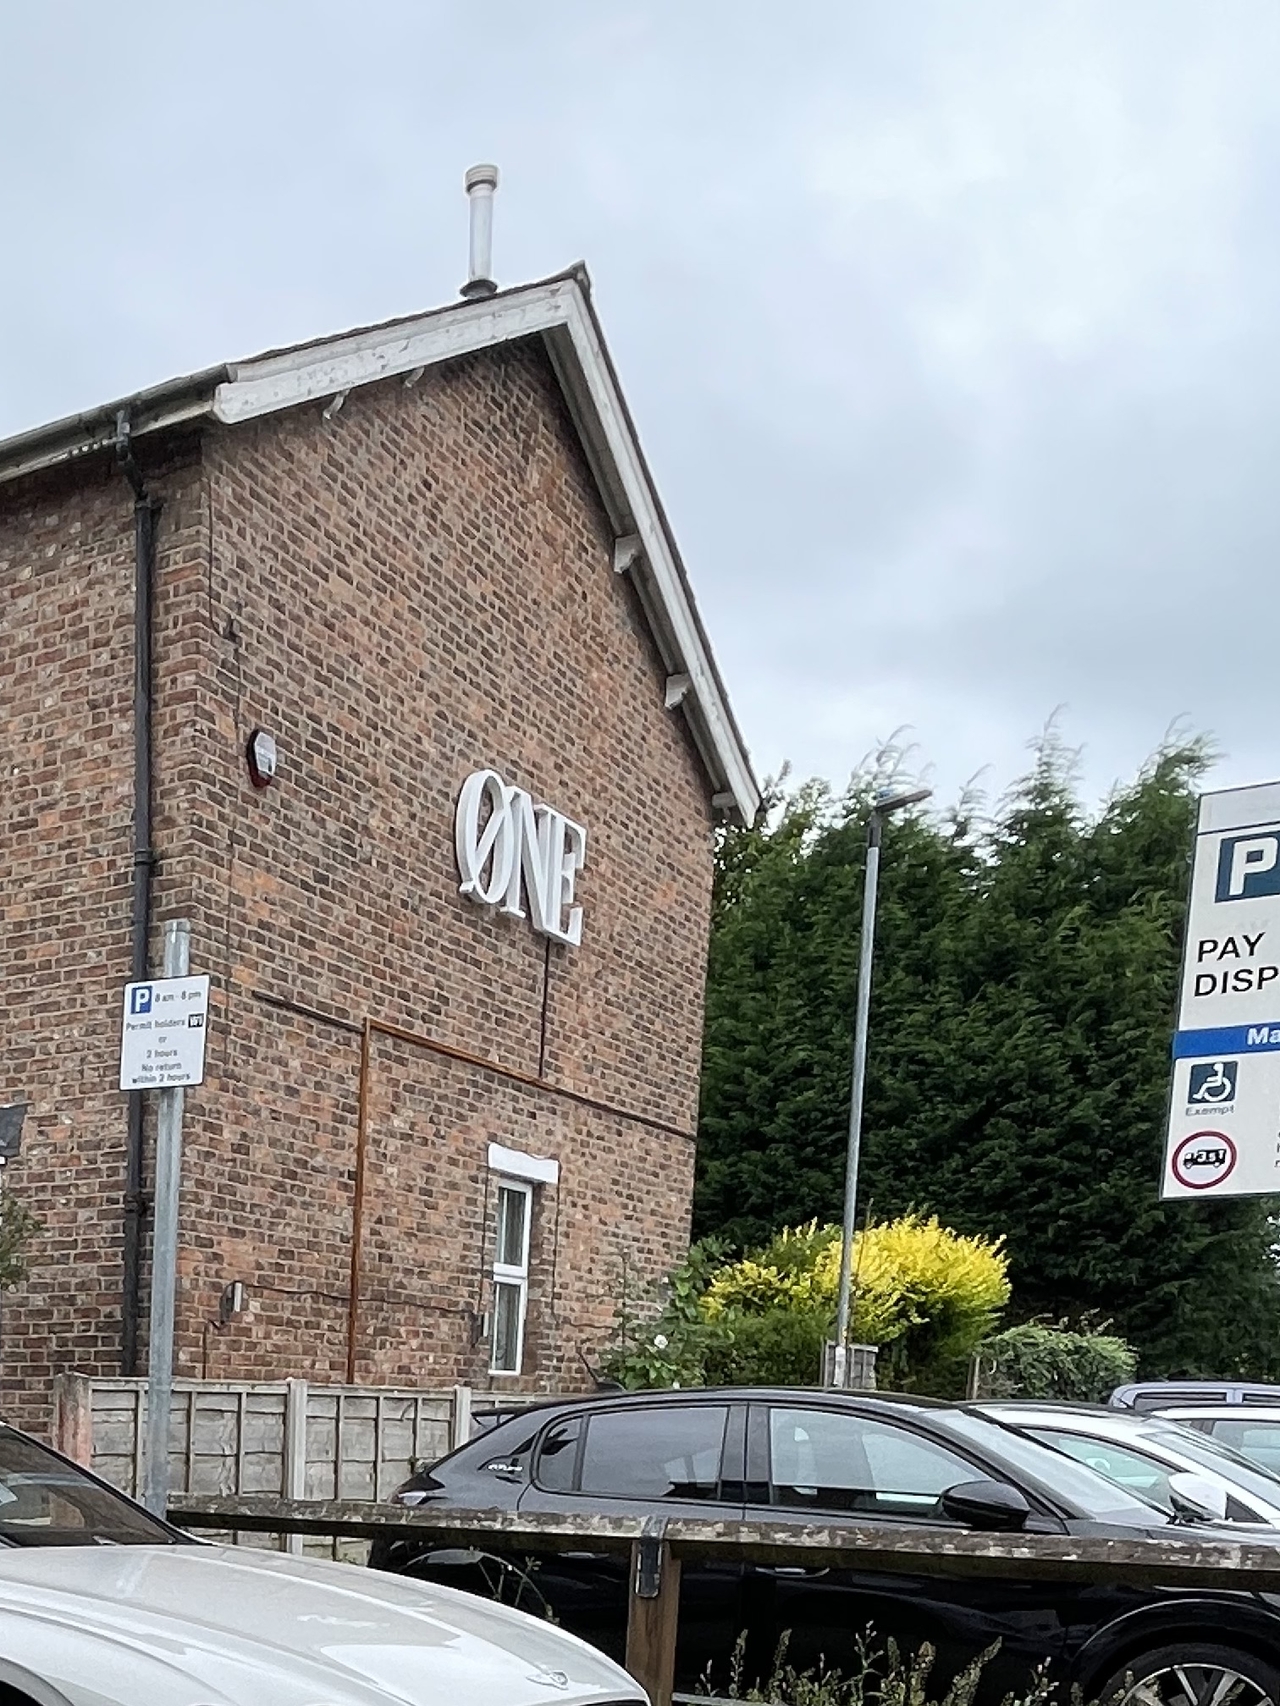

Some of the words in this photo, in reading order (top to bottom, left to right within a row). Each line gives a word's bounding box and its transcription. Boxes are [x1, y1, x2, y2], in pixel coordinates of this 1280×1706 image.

[1229, 836, 1279, 896] P
[1197, 931, 1266, 963] PAY
[1194, 966, 1280, 997] DISP
[135, 988, 150, 1013] P
[162, 994, 174, 1002] am
[188, 991, 202, 1000] pm
[126, 1021, 152, 1031] Permit
[154, 1019, 186, 1028] holders
[146, 1050, 152, 1058] 2
[154, 1049, 178, 1058] hours
[141, 1064, 154, 1072] No
[155, 1062, 182, 1071] return
[132, 1074, 157, 1084] within
[159, 1074, 165, 1082] 2
[167, 1073, 191, 1081] hours
[1185, 1104, 1235, 1117] Exempt
